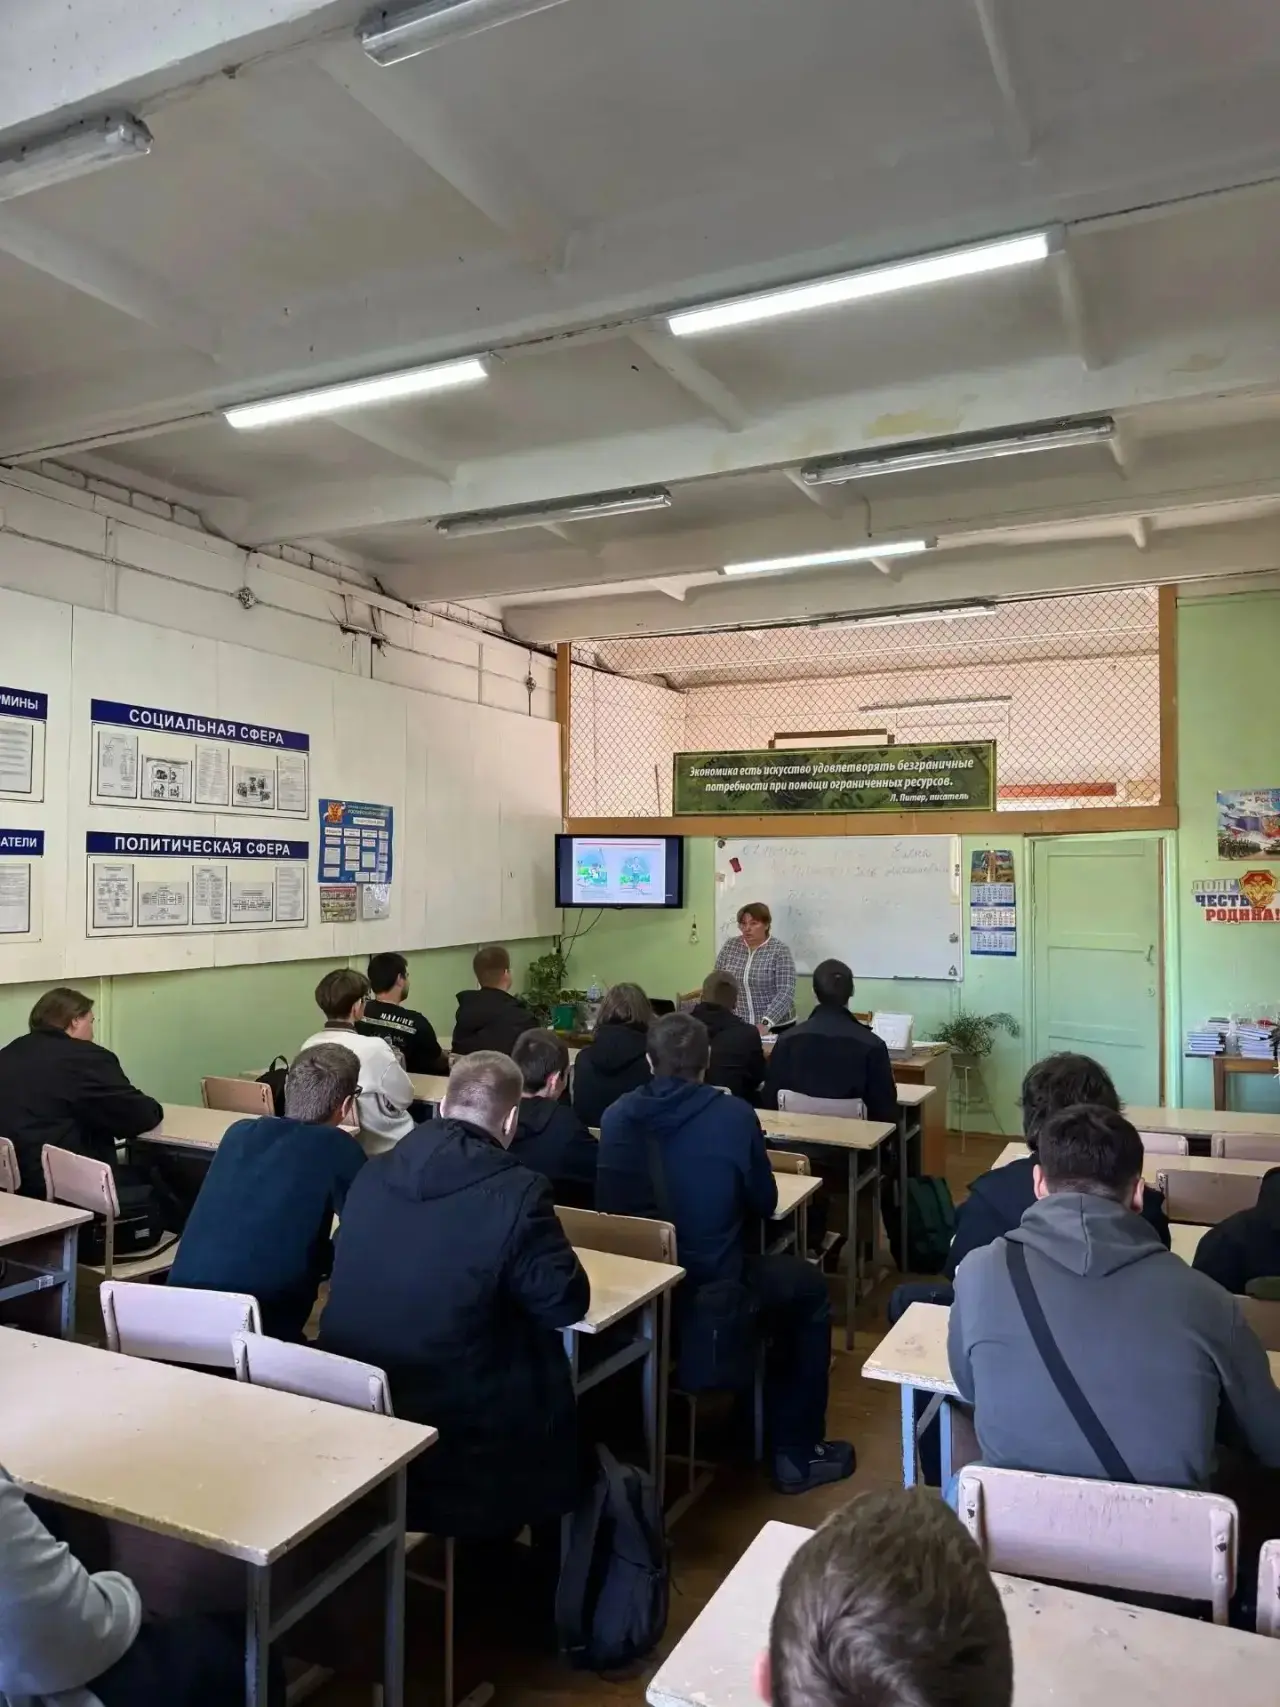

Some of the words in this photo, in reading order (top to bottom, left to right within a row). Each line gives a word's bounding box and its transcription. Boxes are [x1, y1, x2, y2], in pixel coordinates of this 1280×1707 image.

[0, 690, 38, 710] МИНЫ
[128, 709, 236, 738] СОЦИАЛЬНАЯ
[239, 726, 285, 745] СФЕРА
[689, 766, 738, 777] Экономика
[739, 766, 762, 776] есть
[763, 765, 811, 777] искусство
[813, 762, 895, 776] удовлетворять
[897, 757, 974, 773] безграничные
[705, 780, 768, 793] потребности
[769, 781, 786, 793] при
[788, 779, 828, 791] помощи
[829, 777, 902, 790] ограниченных
[903, 776, 953, 790] ресурсов.
[889, 793, 899, 802] Л.
[899, 793, 928, 803] Питер,
[929, 792, 969, 802] писатель
[114, 836, 242, 855] ПОЛИТИЧЕСКАЯ
[246, 840, 291, 857] СФЕРА
[1192, 878, 1236, 893] ДОЛГ
[1195, 894, 1250, 907] ЧЕСТЬ
[1205, 908, 1280, 923] РОДИНА!
